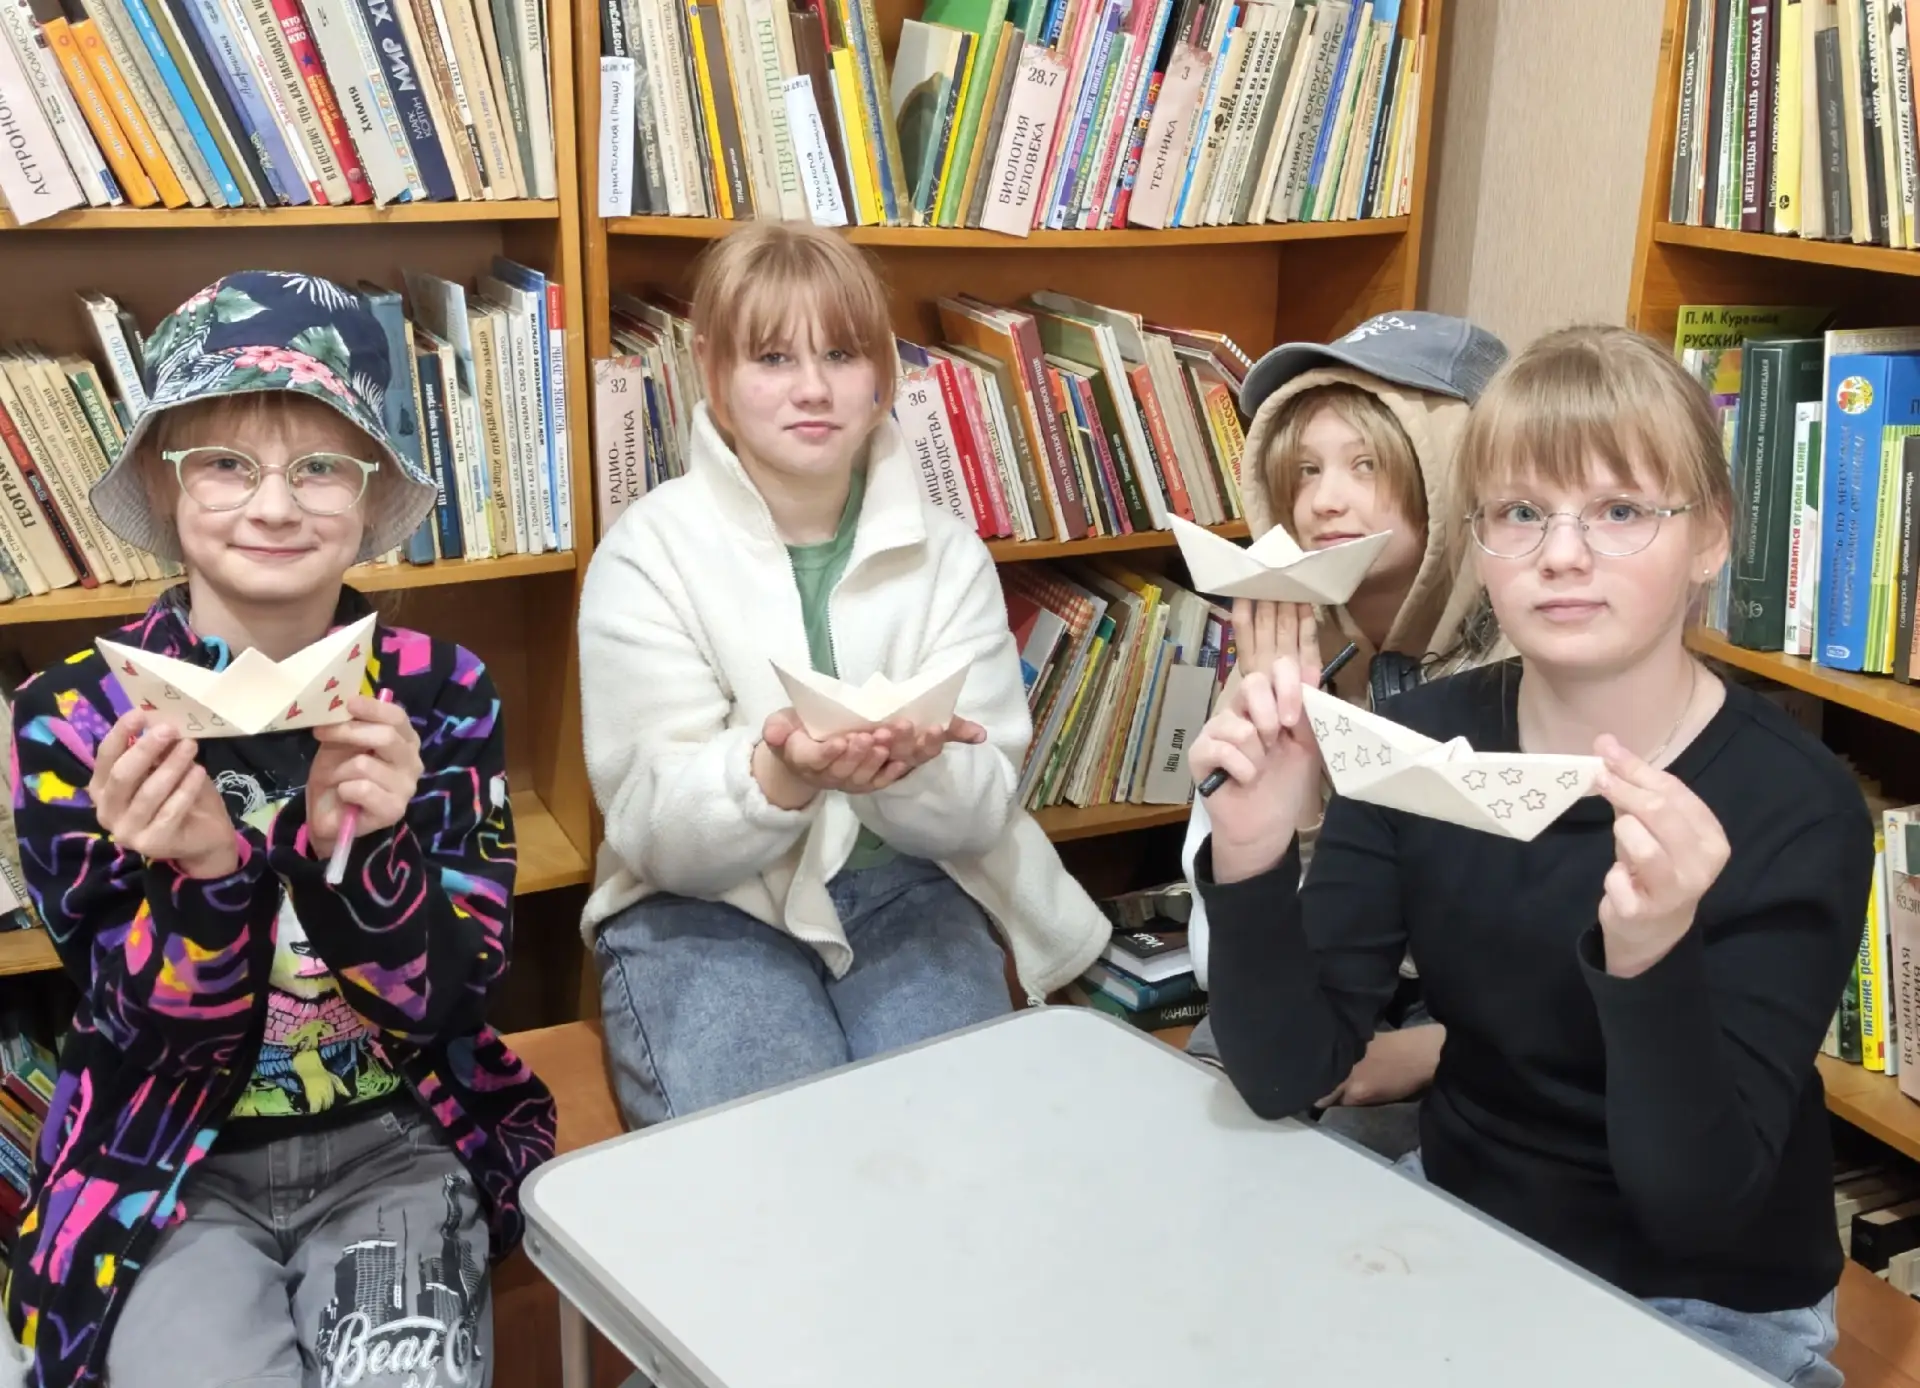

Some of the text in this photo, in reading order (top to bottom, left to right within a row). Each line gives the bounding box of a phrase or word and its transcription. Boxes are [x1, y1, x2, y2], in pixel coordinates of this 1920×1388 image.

[263, 25, 294, 80] НАБЛЮДАТЬ
[379, 34, 416, 94] МИР
[1092, 30, 1112, 93] ПРИКЛЮЧЕНИЯ
[1237, 29, 1258, 73] КОЛЕСАХ
[1750, 19, 1763, 77] СОБАКАХ
[1867, 0, 1882, 127] КНИГА СОБАКОВОД
[286, 80, 302, 99] КАК
[1028, 66, 1058, 87] 28.7
[1117, 53, 1141, 117] ЧЕЛОВЕК
[1181, 65, 1192, 81] 3
[1234, 76, 1243, 90] НА
[1236, 92, 1253, 131] ЧУДЕСА
[1248, 76, 1257, 90] НА
[1253, 30, 1271, 73] КОЛЕСАХ
[1246, 30, 1281, 132] ЧУДЕСА НА КОЛЕСАХ
[406, 110, 423, 140] МАРК
[756, 17, 797, 194] ПЕВЧИЕ ПТИЦЫ
[1221, 93, 1239, 131] ЧУДЕСА
[1284, 31, 1331, 198] ТЕХНИКА ВОКРУГ НАС
[1297, 22, 1344, 191] ТЕХНИКА ВОКРУГ НАС
[1680, 52, 1695, 157] БОЛЕЗНИ СОБАК
[1748, 89, 1758, 128] БЫЛЬ
[0, 93, 51, 200] АСТРОНО
[999, 115, 1030, 204] БИОЛОГИЯ
[1017, 122, 1046, 206] ЧЕЛОВЕКА
[1151, 119, 1178, 190] ТЕХНИКА
[1744, 140, 1757, 202] ЛЕГЕНДЫ
[529, 312, 539, 354] ОТКРЫТИЯ
[1683, 330, 1744, 347] РУССКИЙ
[1685, 311, 1716, 325] П. М.
[515, 336, 525, 365] ЗЕМЛЮ
[551, 346, 562, 376] ЛУНЫ
[518, 368, 527, 391] СВОЮ
[531, 357, 545, 425] ГЕОГРАФИЧЕСКИЕ
[610, 378, 627, 393] 32
[906, 388, 928, 407] 36
[8, 398, 37, 445] ГЕОГРАФИИ
[520, 394, 531, 439] ОТКРЫВАЛИ
[553, 388, 565, 434] ЧЕЛОВЕК
[1218, 392, 1236, 427] СССР
[33, 444, 60, 486] УЧЕБНИКА
[524, 442, 533, 465] ЛЮДИ
[608, 441, 622, 504] РАДИО-
[624, 410, 638, 505] КТРОНИКА
[914, 437, 943, 506] ИЩЕВЫЕ
[1751, 435, 1766, 503] МЕДИЦИНСКАЯ
[1795, 441, 1806, 473] СПИНЕ
[1062, 475, 1075, 501] КНИГА
[1793, 483, 1803, 511] БОЛИ
[55, 485, 88, 539] СТРАНИЦАМИ
[1793, 513, 1801, 525] ОТ
[1836, 512, 1845, 532] ПО
[84, 539, 94, 550] ЗА
[1788, 527, 1802, 587] ИЗБАВИТЬСЯ
[1787, 589, 1797, 609] КАК
[1163, 728, 1186, 772] НАШ ДОМ
[1861, 979, 1873, 1036] питание
[1901, 947, 1913, 1064] ВСЕМИРНАЯ
